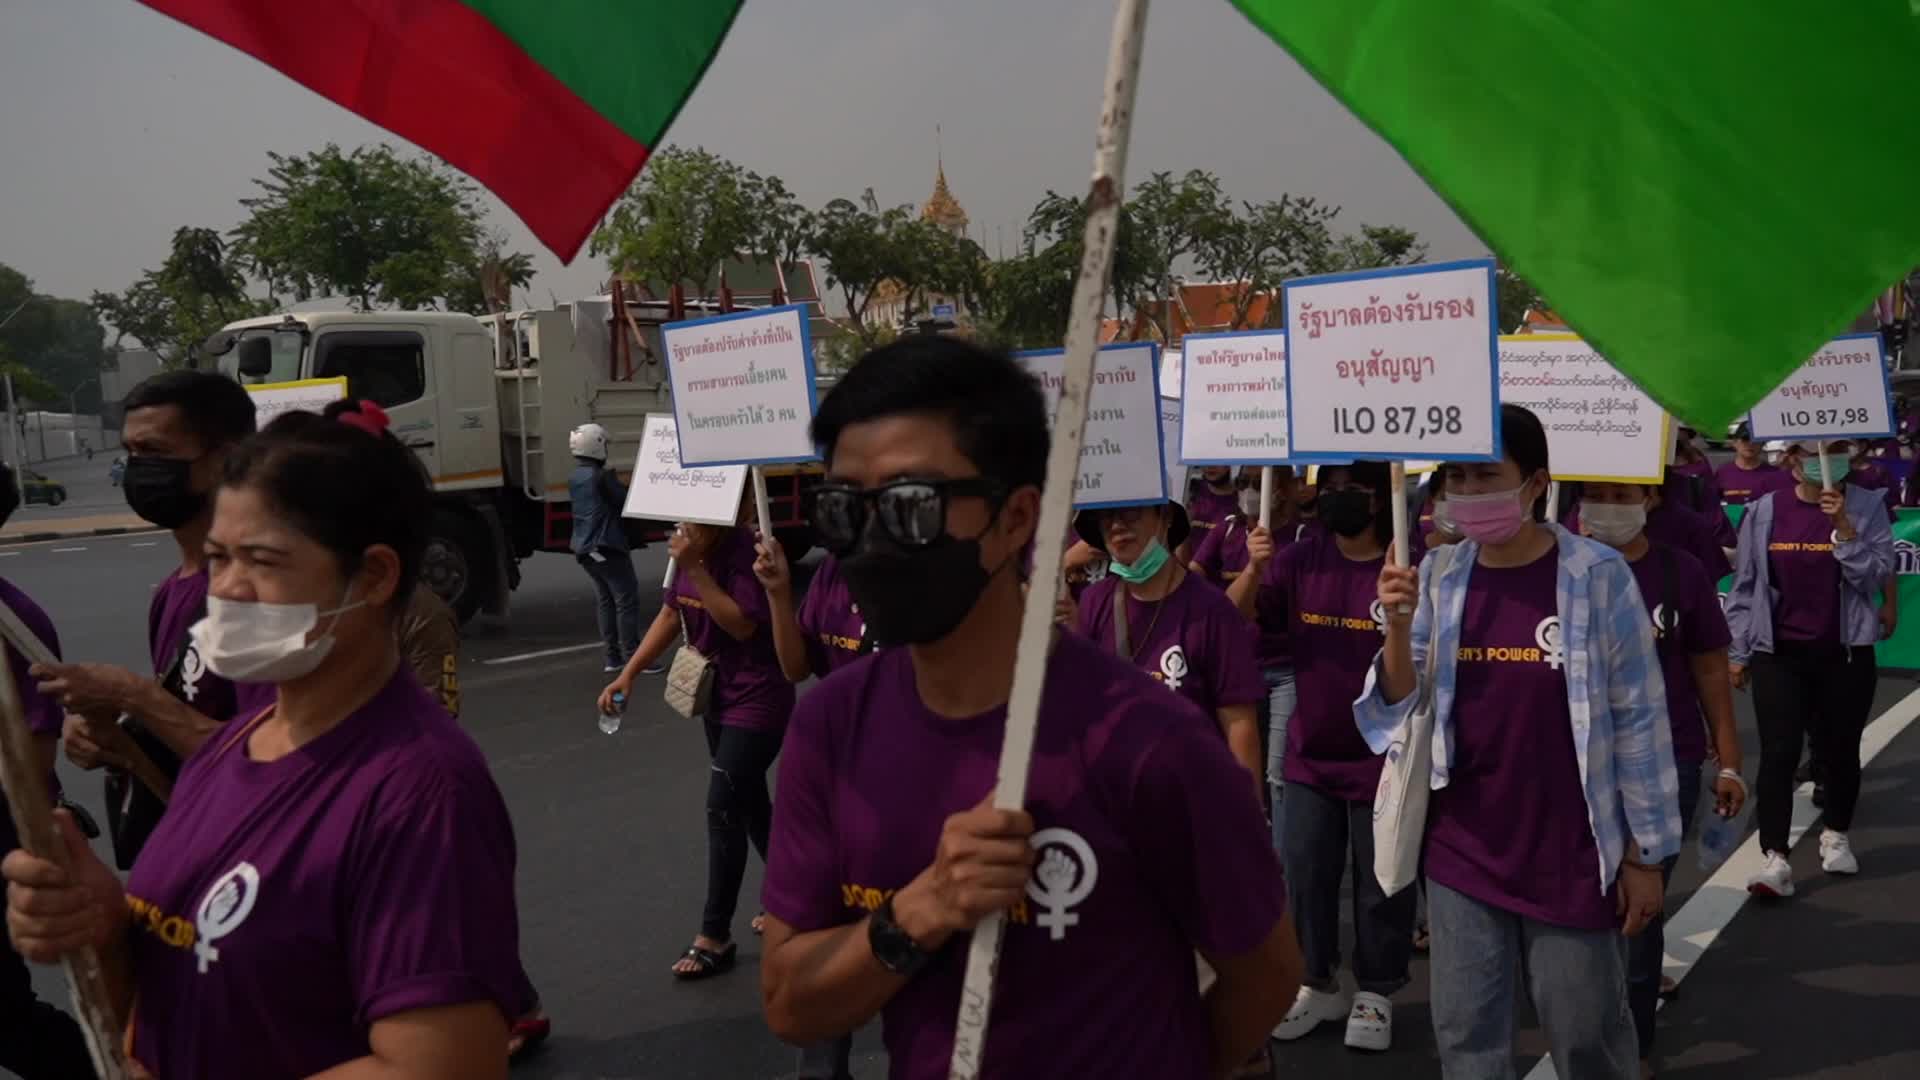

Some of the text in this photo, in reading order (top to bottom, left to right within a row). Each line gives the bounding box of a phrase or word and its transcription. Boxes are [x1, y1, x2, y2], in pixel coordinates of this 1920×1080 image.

[1299, 293, 1475, 338] รัฐบาลต้องรับรอง
[1335, 350, 1434, 386] อนุสัญญา
[1781, 380, 1848, 399] อนุสัญญา
[766, 409, 775, 423] 3
[1333, 405, 1462, 439] ILO 87,98
[1781, 408, 1869, 427] ILO 87,98
[1487, 647, 1540, 661] POWER
